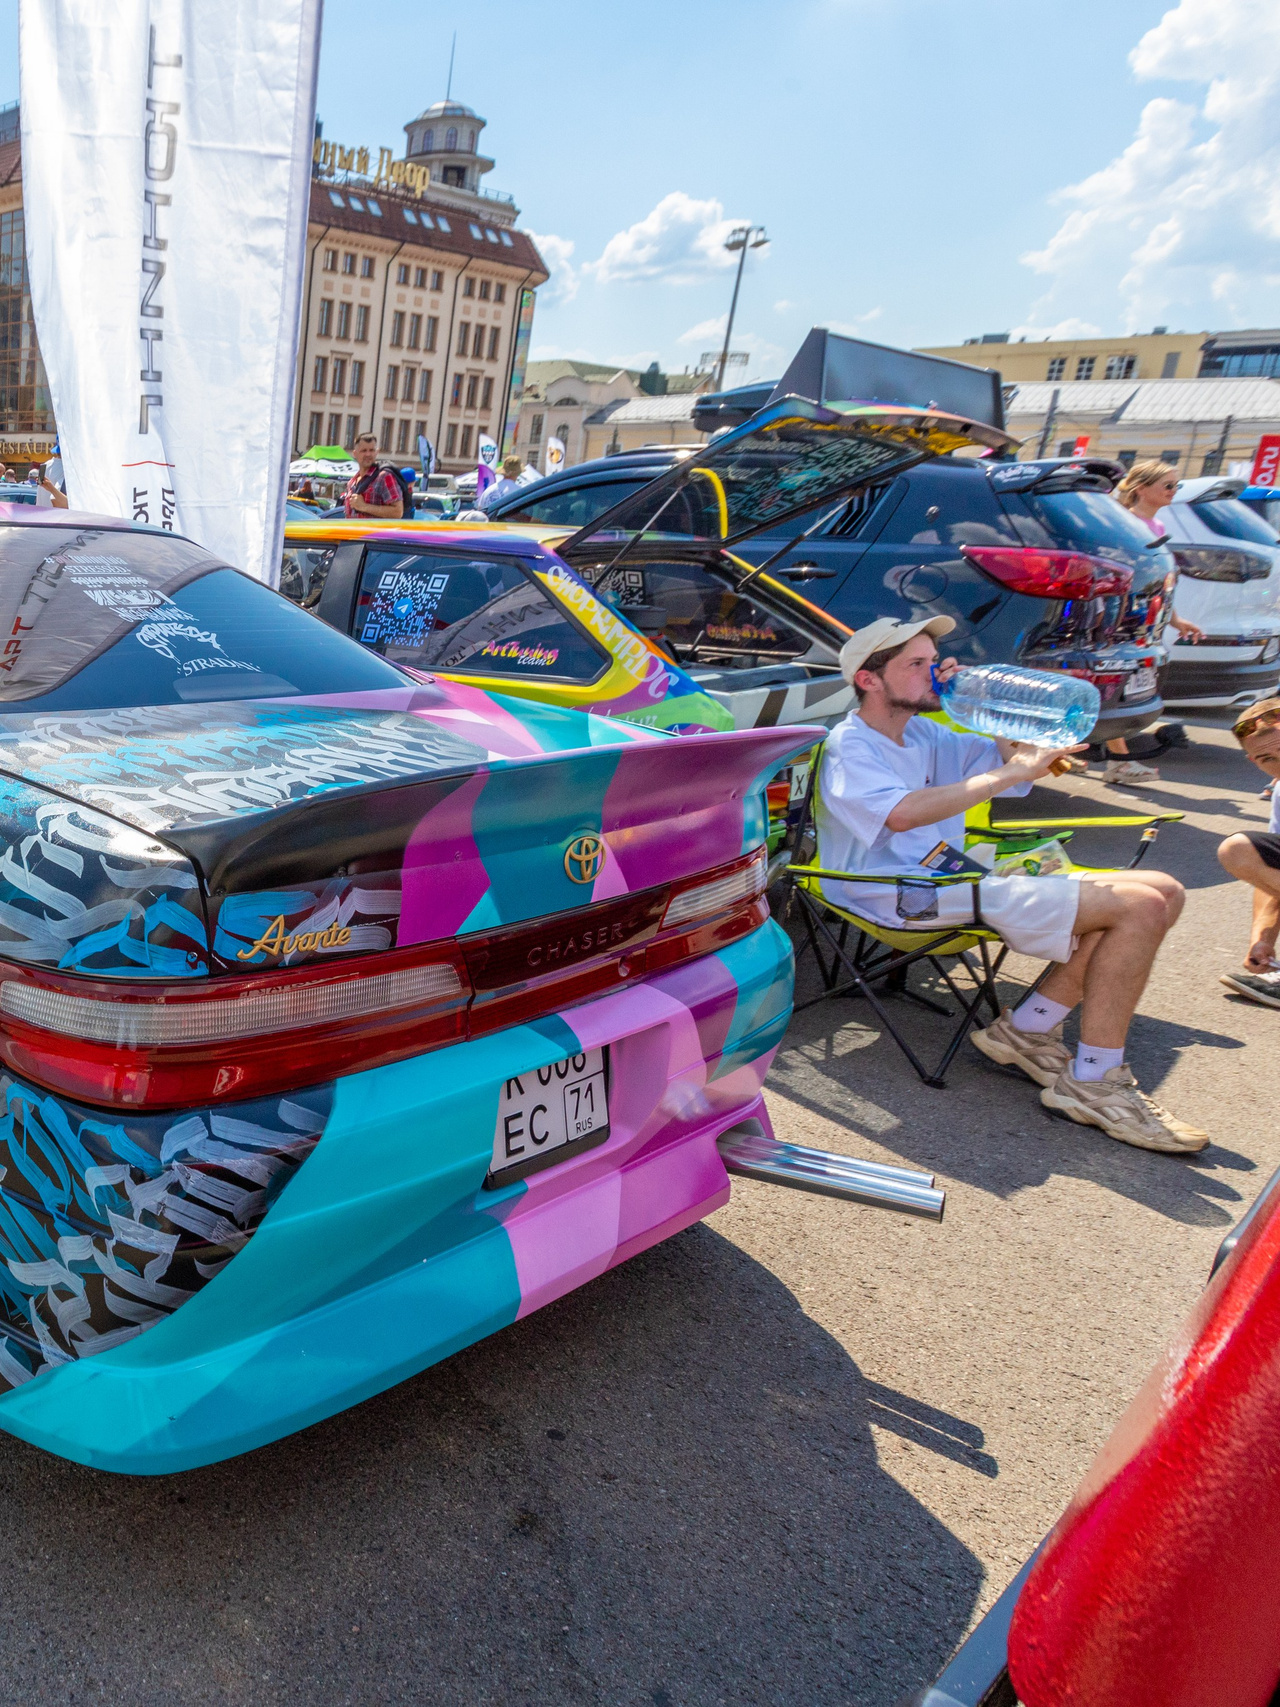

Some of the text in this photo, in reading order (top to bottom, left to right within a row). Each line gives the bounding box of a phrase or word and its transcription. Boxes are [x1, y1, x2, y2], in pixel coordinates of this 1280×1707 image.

[237, 914, 352, 960] Avante
[527, 922, 624, 966] CHASER
[504, 1082, 595, 1158] EC 71
[576, 1117, 594, 1134] RUS
